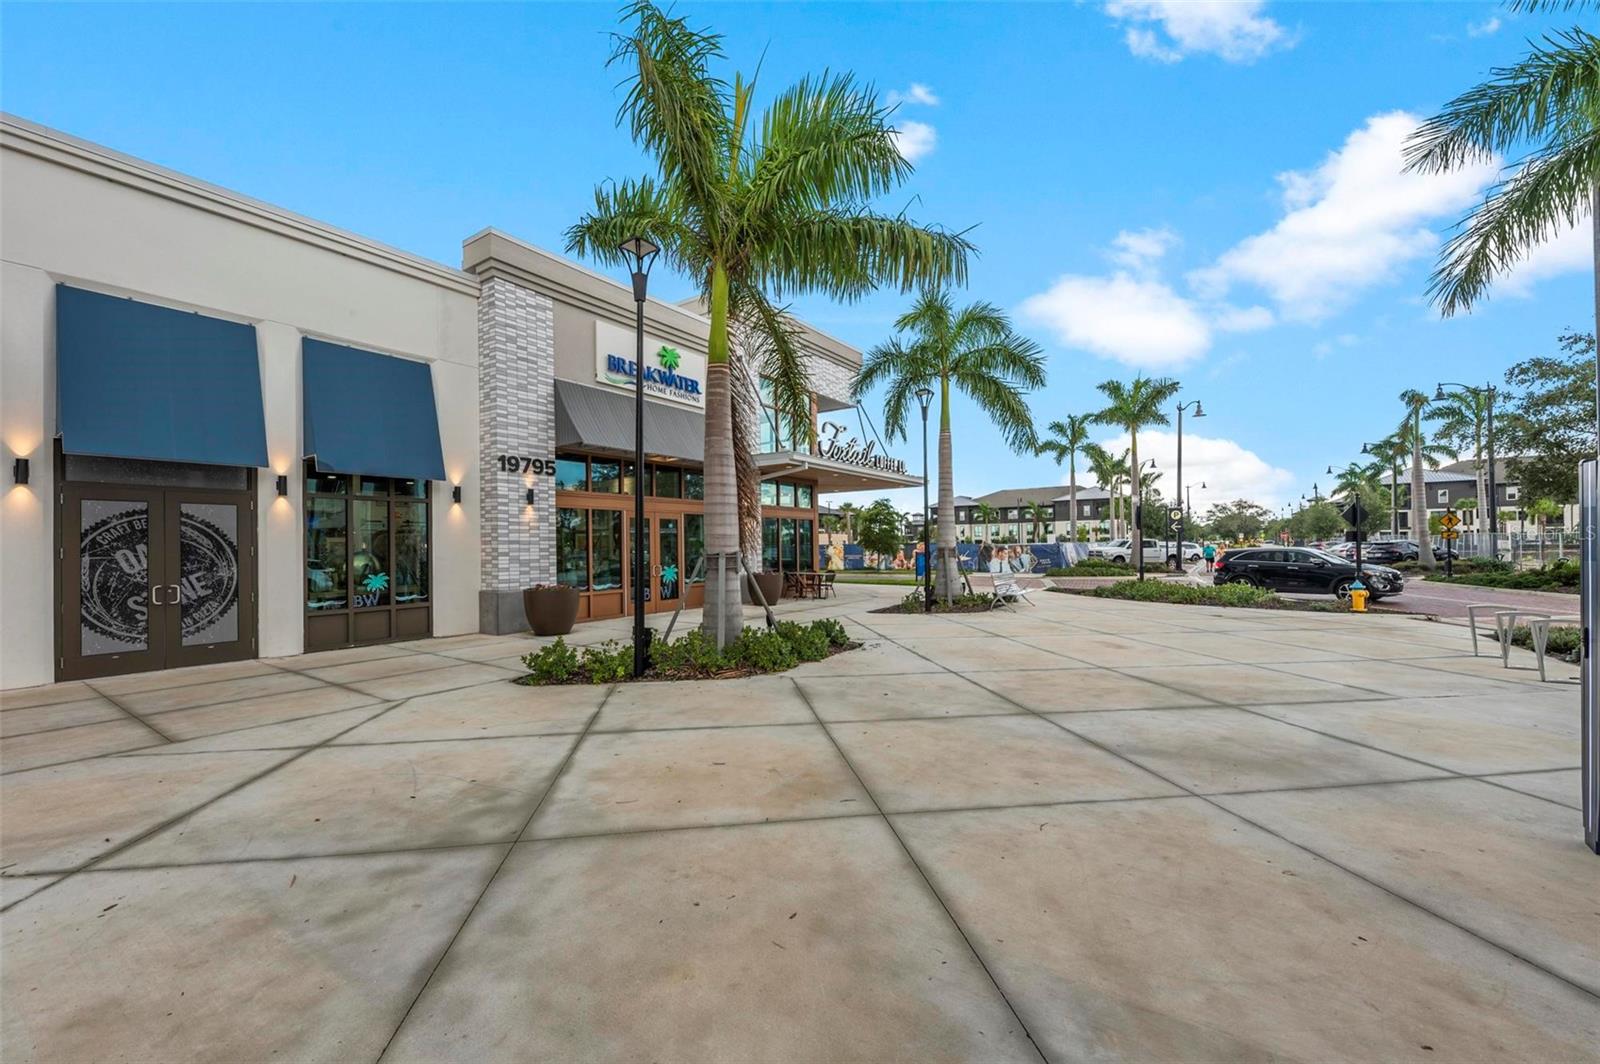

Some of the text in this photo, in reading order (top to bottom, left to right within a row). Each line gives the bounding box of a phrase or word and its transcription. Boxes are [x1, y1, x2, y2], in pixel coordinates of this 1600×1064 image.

[647, 385, 700, 403] HOME FASHIONS
[497, 454, 556, 476] 19795
[96, 519, 148, 545] CRAFT BE
[353, 590, 379, 608] BW
